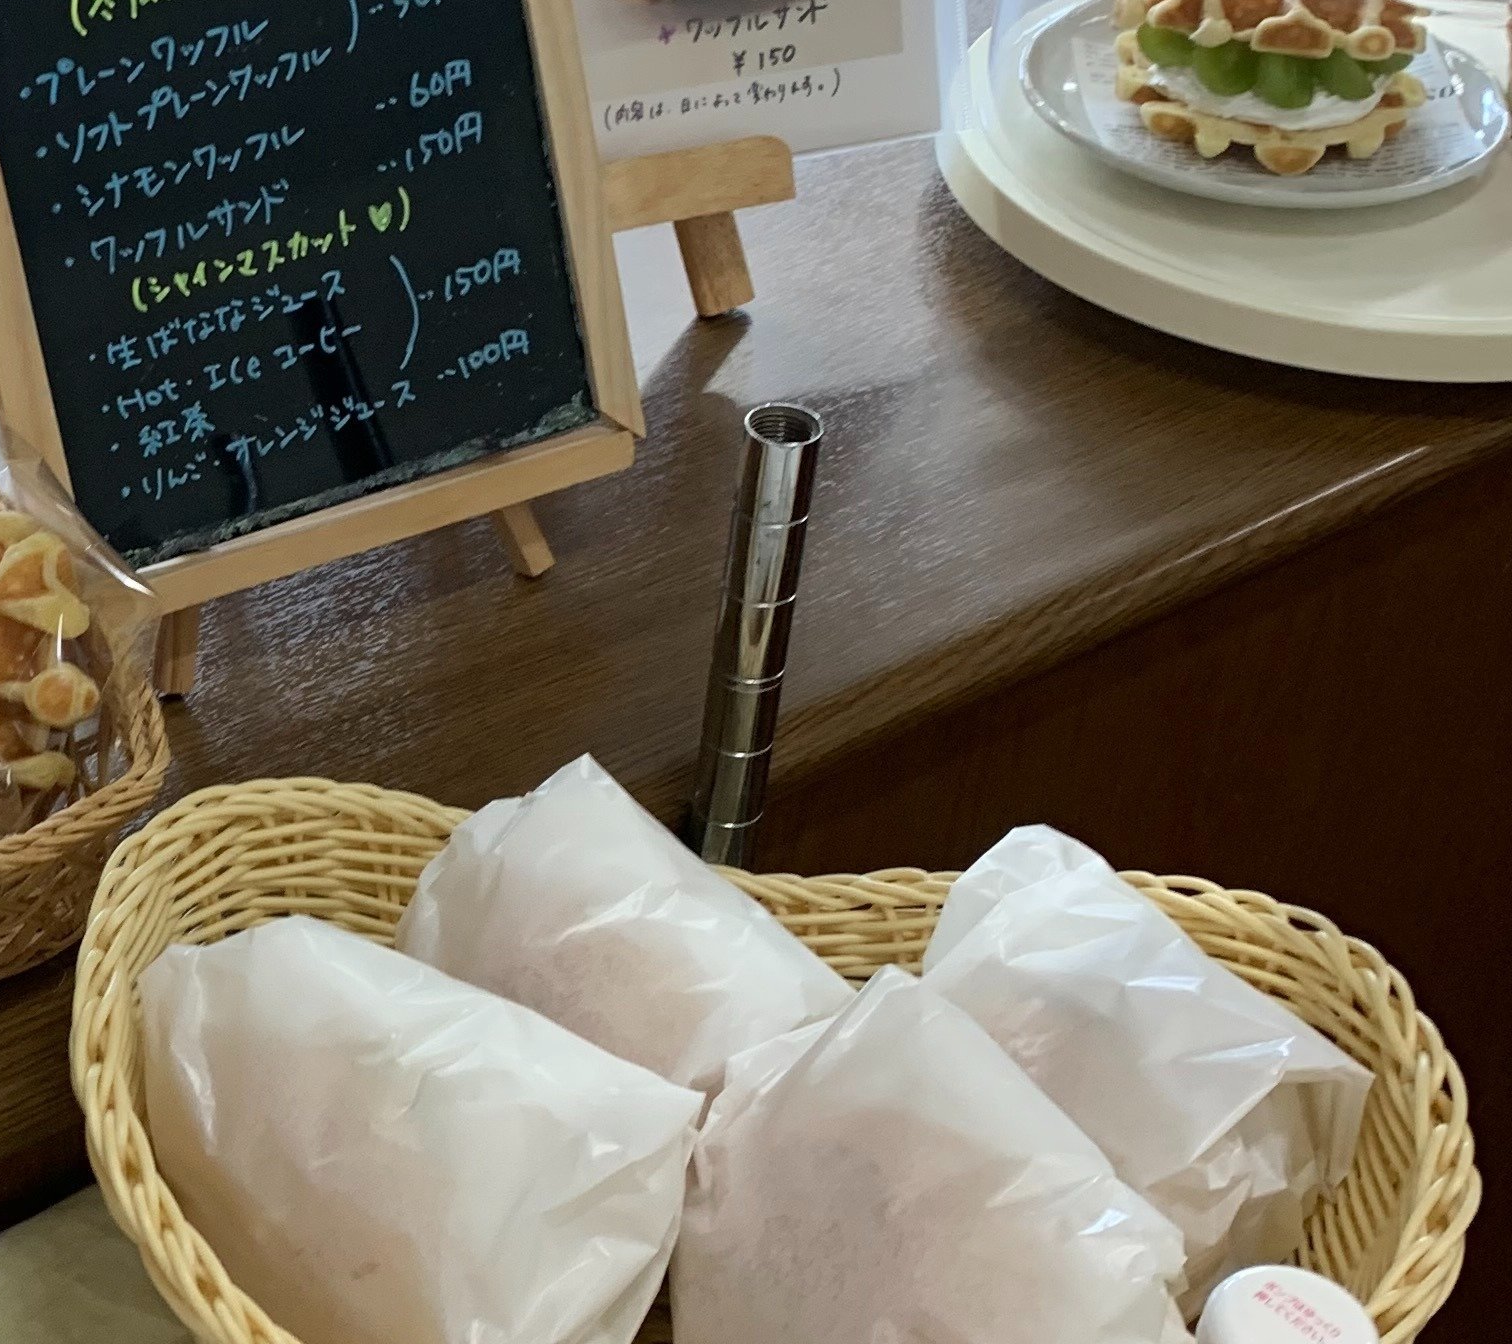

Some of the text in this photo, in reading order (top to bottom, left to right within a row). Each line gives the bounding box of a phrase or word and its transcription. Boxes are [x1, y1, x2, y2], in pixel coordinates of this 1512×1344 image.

[35, 18, 270, 106] プレーンワッフル
[56, 46, 333, 164] ソフトプレーンワッフル
[75, 58, 472, 217] シナモンワッフル 60円
[90, 111, 483, 275] ワッフルサンド 150円
[106, 246, 522, 370] 生ばななジュース 150円
[273, 323, 363, 372] コーヒー
[138, 328, 530, 458] 紅茶 100円
